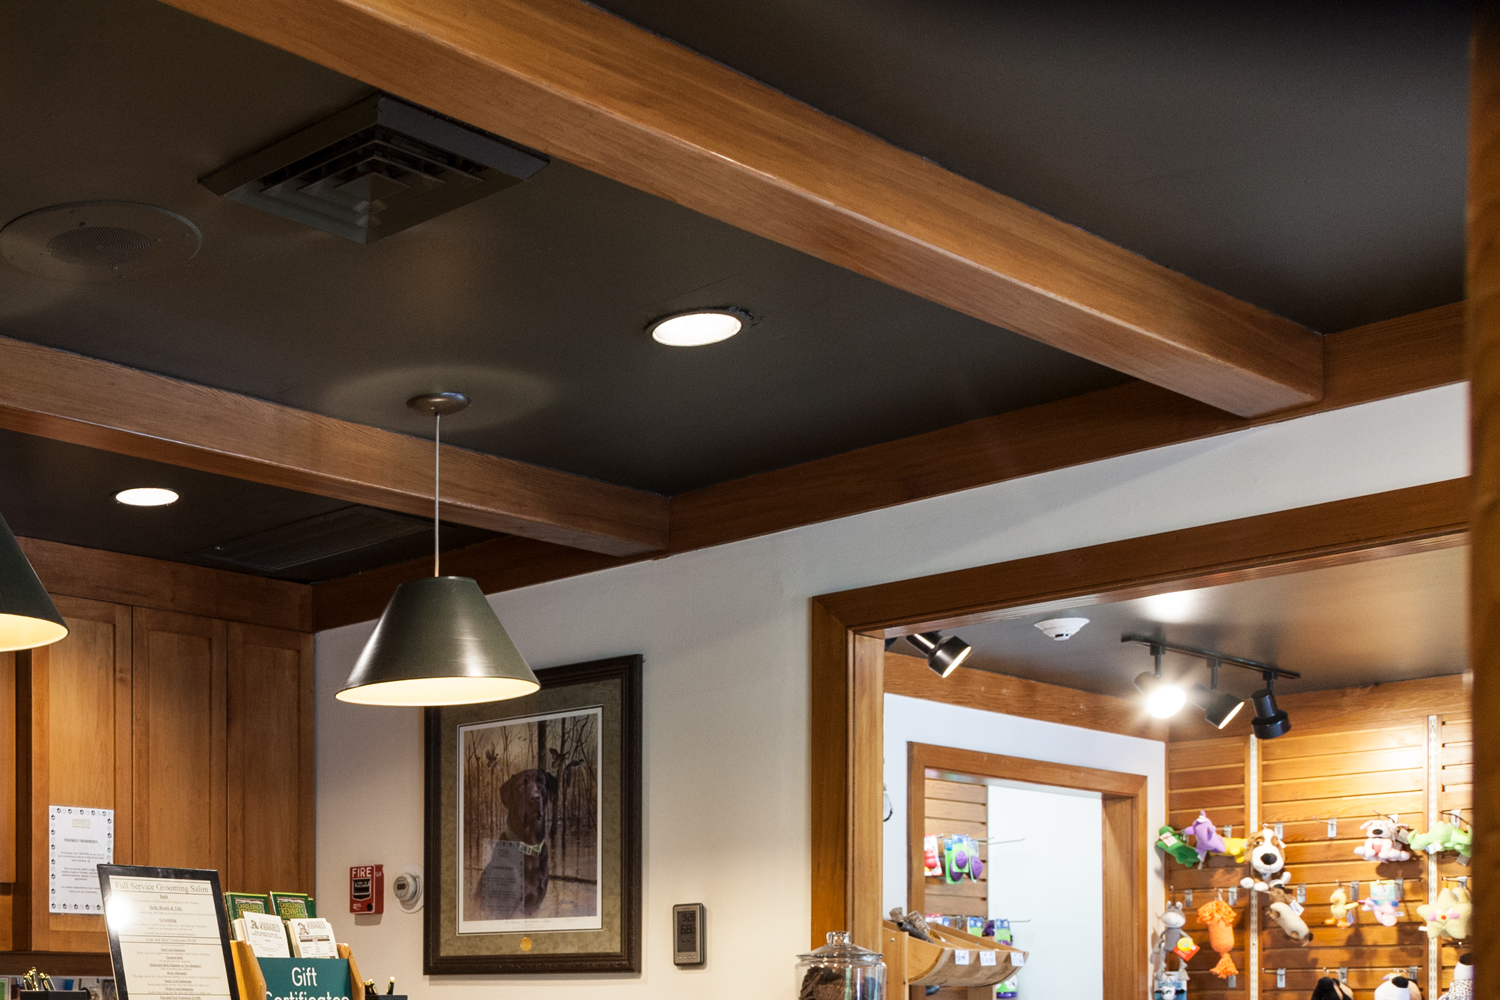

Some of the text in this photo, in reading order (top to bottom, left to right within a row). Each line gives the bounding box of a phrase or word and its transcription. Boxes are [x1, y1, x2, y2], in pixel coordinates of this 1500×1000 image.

[352, 867, 372, 878] FIRE
[131, 882, 155, 891] Service
[156, 883, 189, 893] Grooming
[190, 885, 209, 893] Salon
[291, 967, 317, 986] Gift
